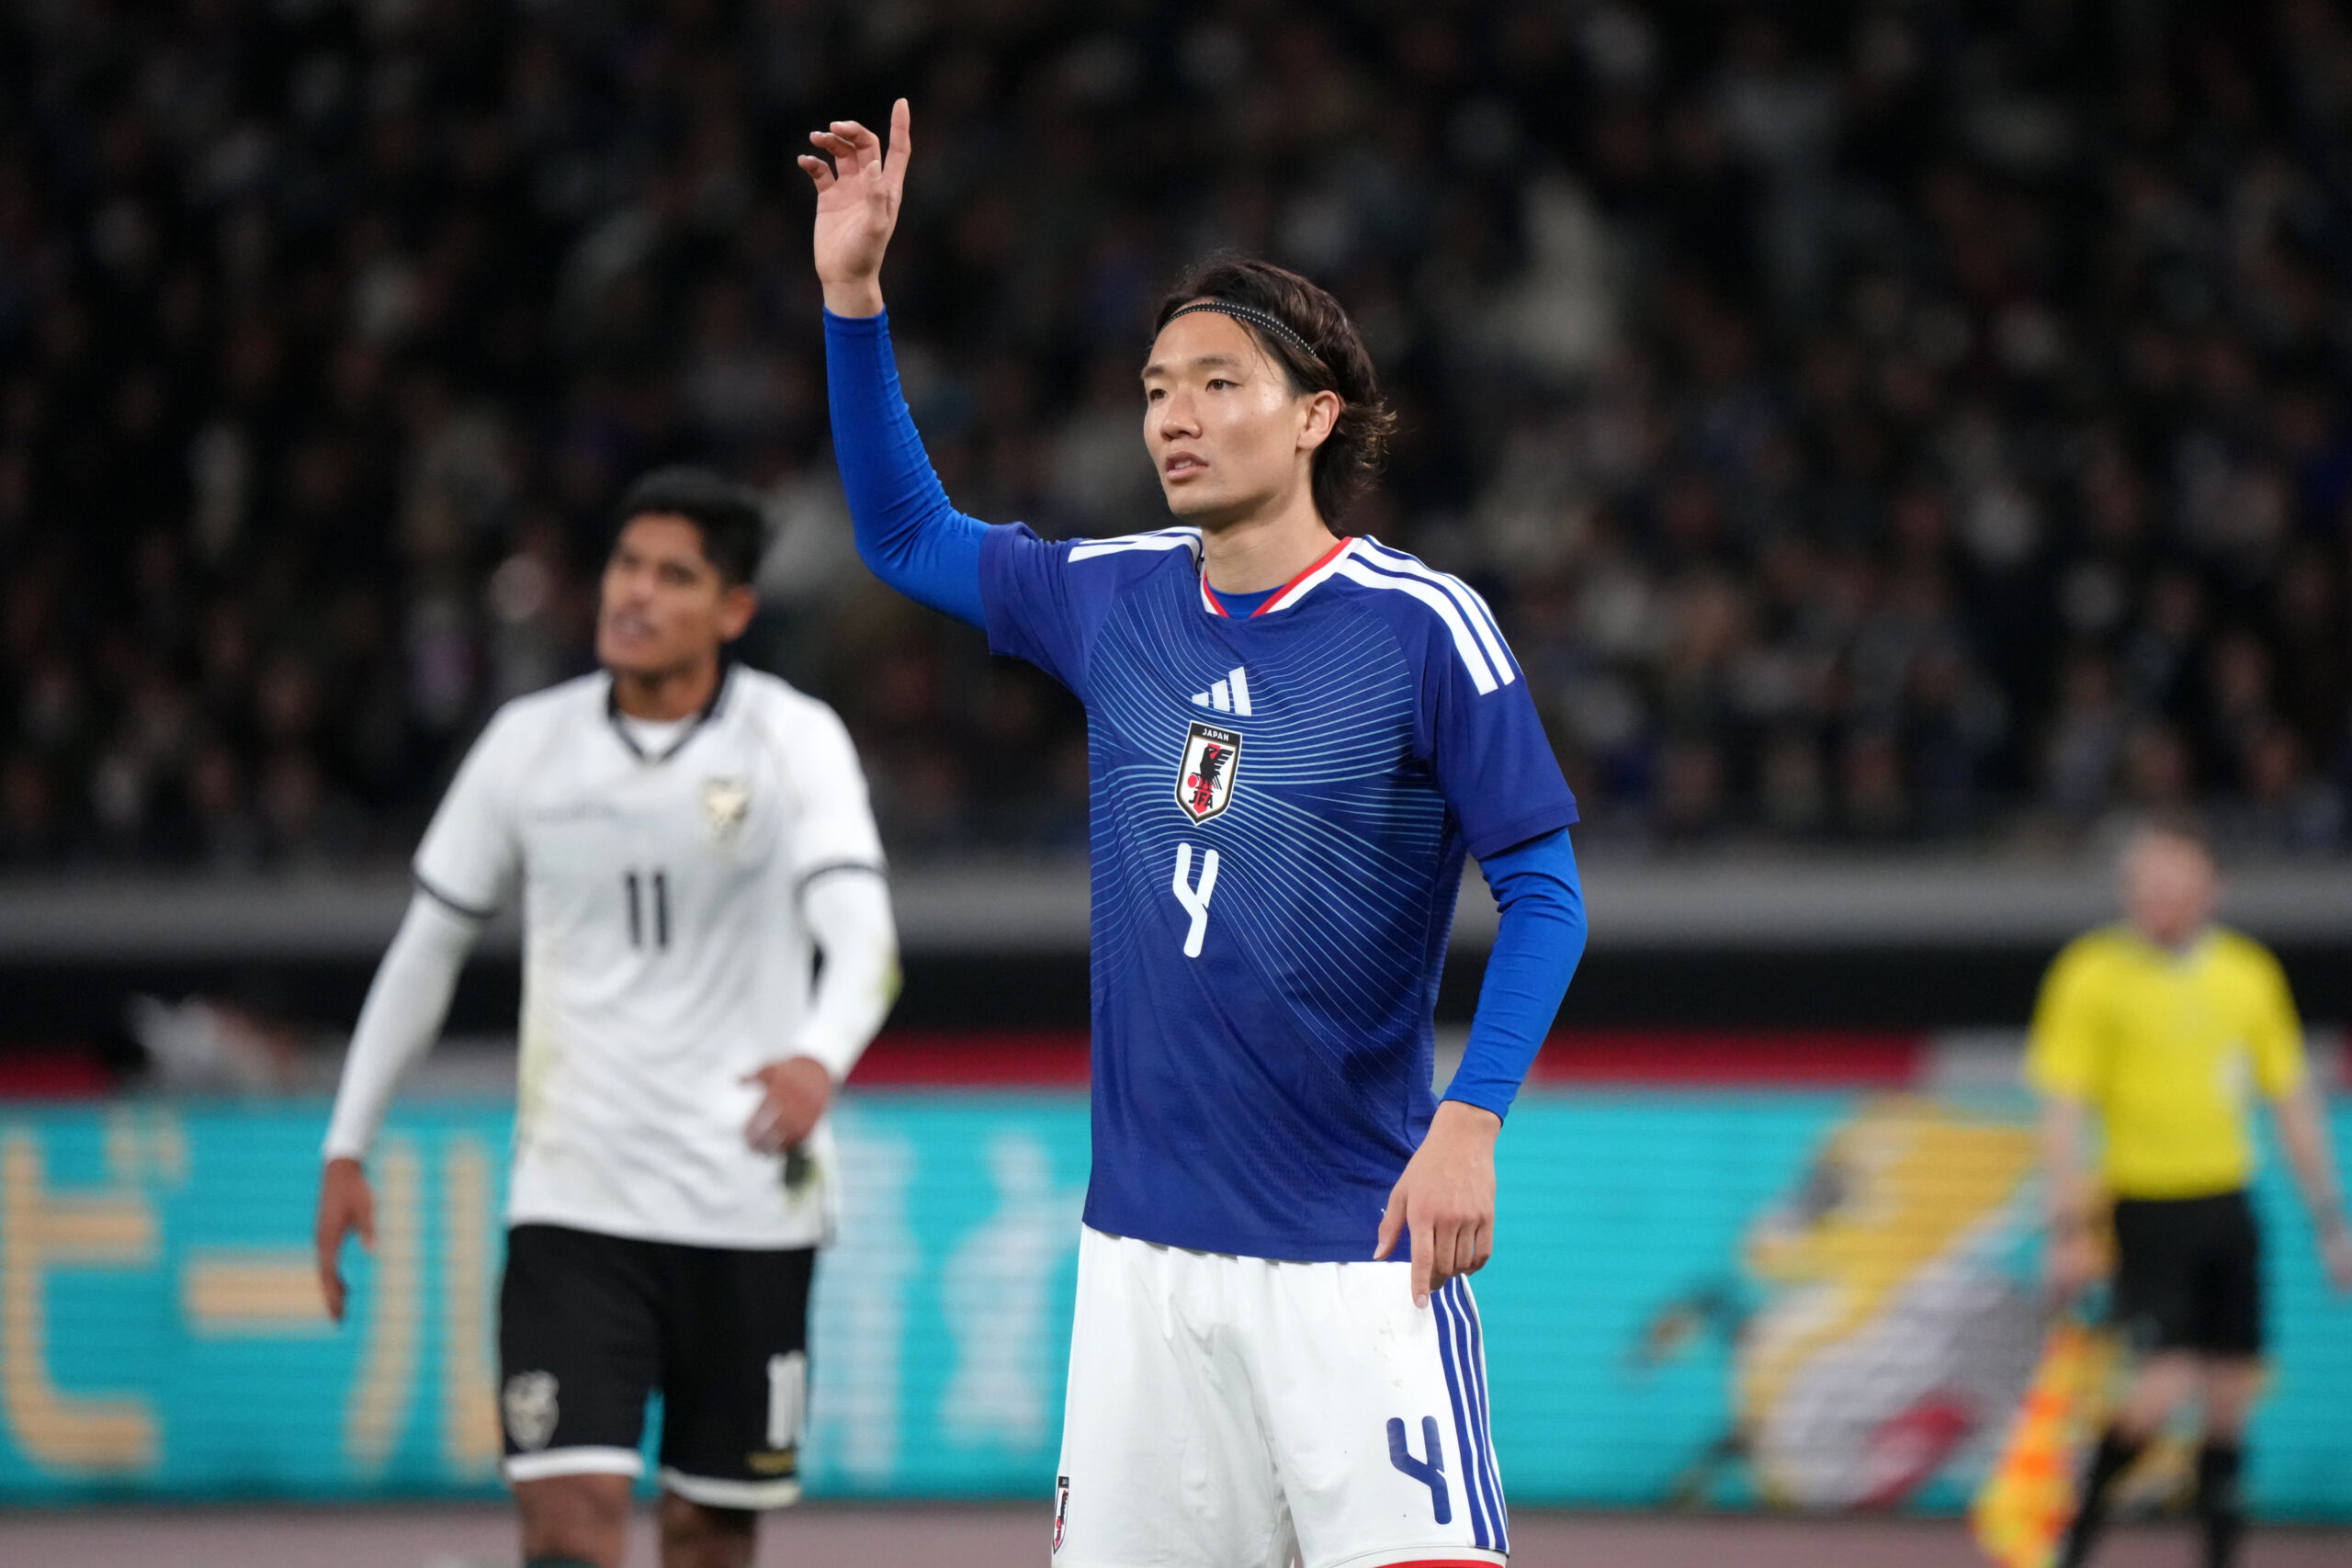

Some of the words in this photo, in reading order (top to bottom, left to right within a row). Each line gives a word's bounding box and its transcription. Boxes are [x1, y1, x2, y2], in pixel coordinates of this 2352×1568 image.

[1202, 728, 1229, 741] JAPAN
[1188, 790, 1214, 809] JFA
[625, 870, 670, 949] 11
[1172, 842, 1220, 958] 4
[1385, 1415, 1453, 1525] 4
